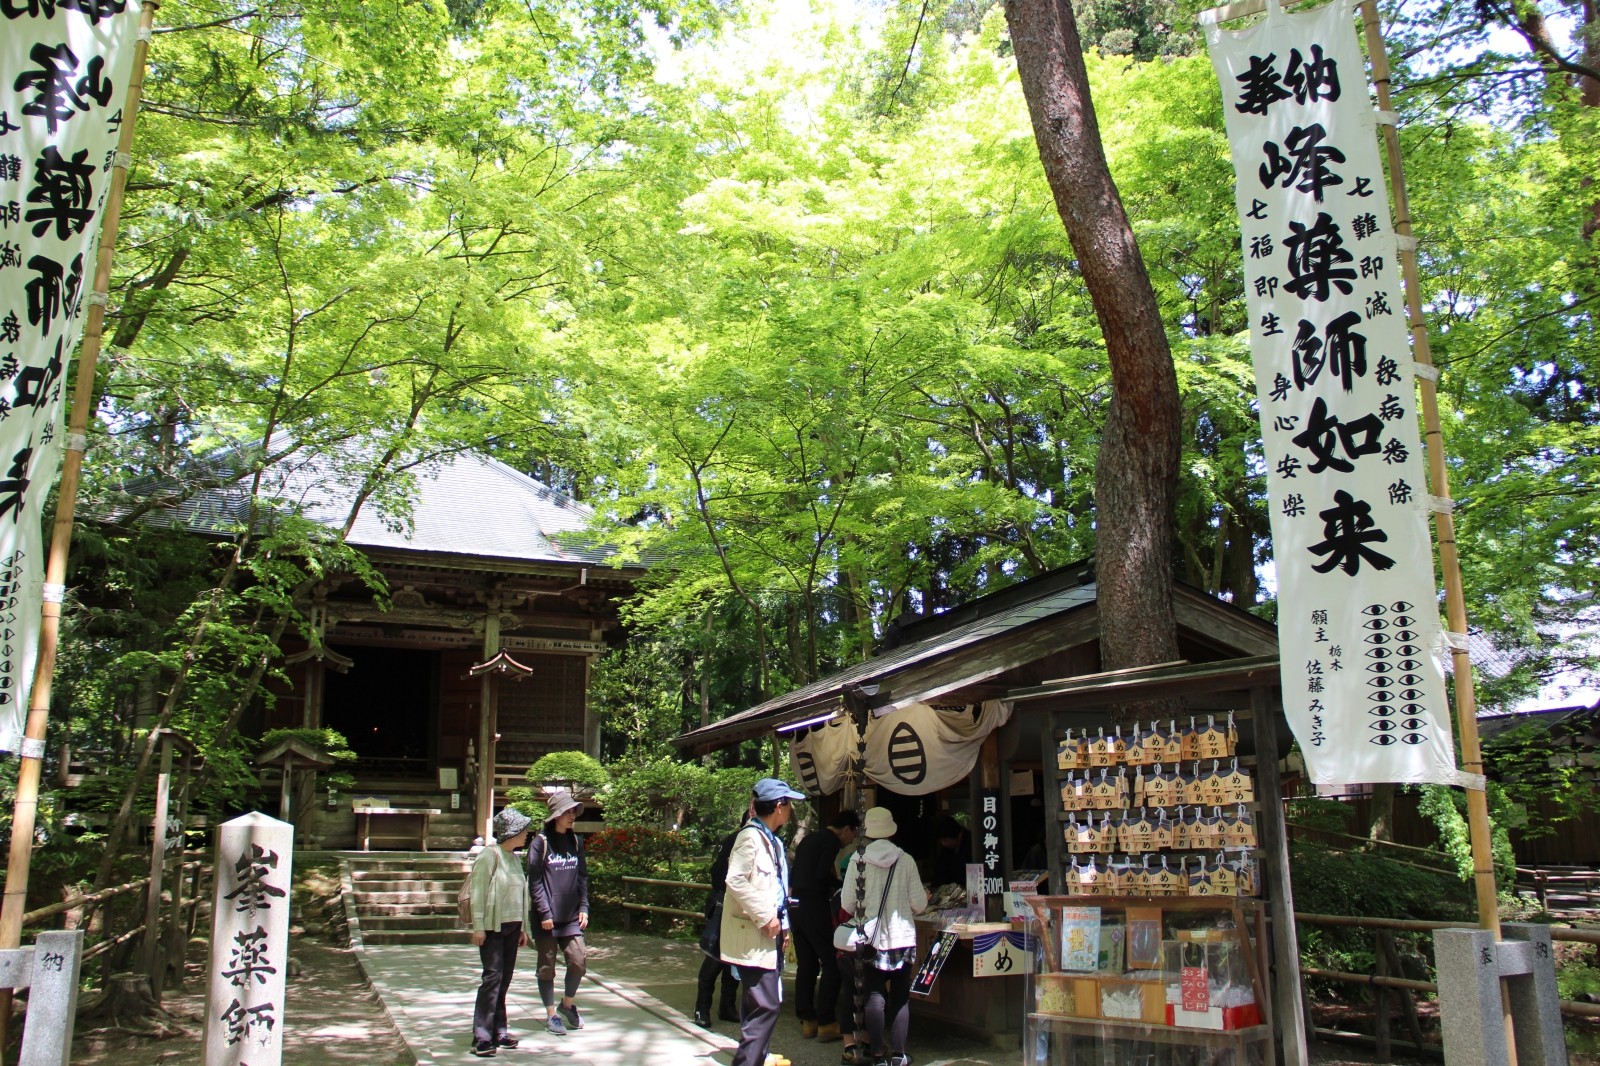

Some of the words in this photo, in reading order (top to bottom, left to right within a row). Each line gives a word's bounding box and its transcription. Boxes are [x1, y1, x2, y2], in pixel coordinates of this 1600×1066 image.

[1234, 43, 1342, 117] 奉納
[1246, 198, 1285, 338] 七福即生
[1258, 122, 1397, 578] 峰薬師如来
[983, 796, 999, 870] 目の御守
[41, 952, 65, 972] 納
[994, 947, 1014, 973] め
[1181, 969, 1195, 1010] おみくじ
